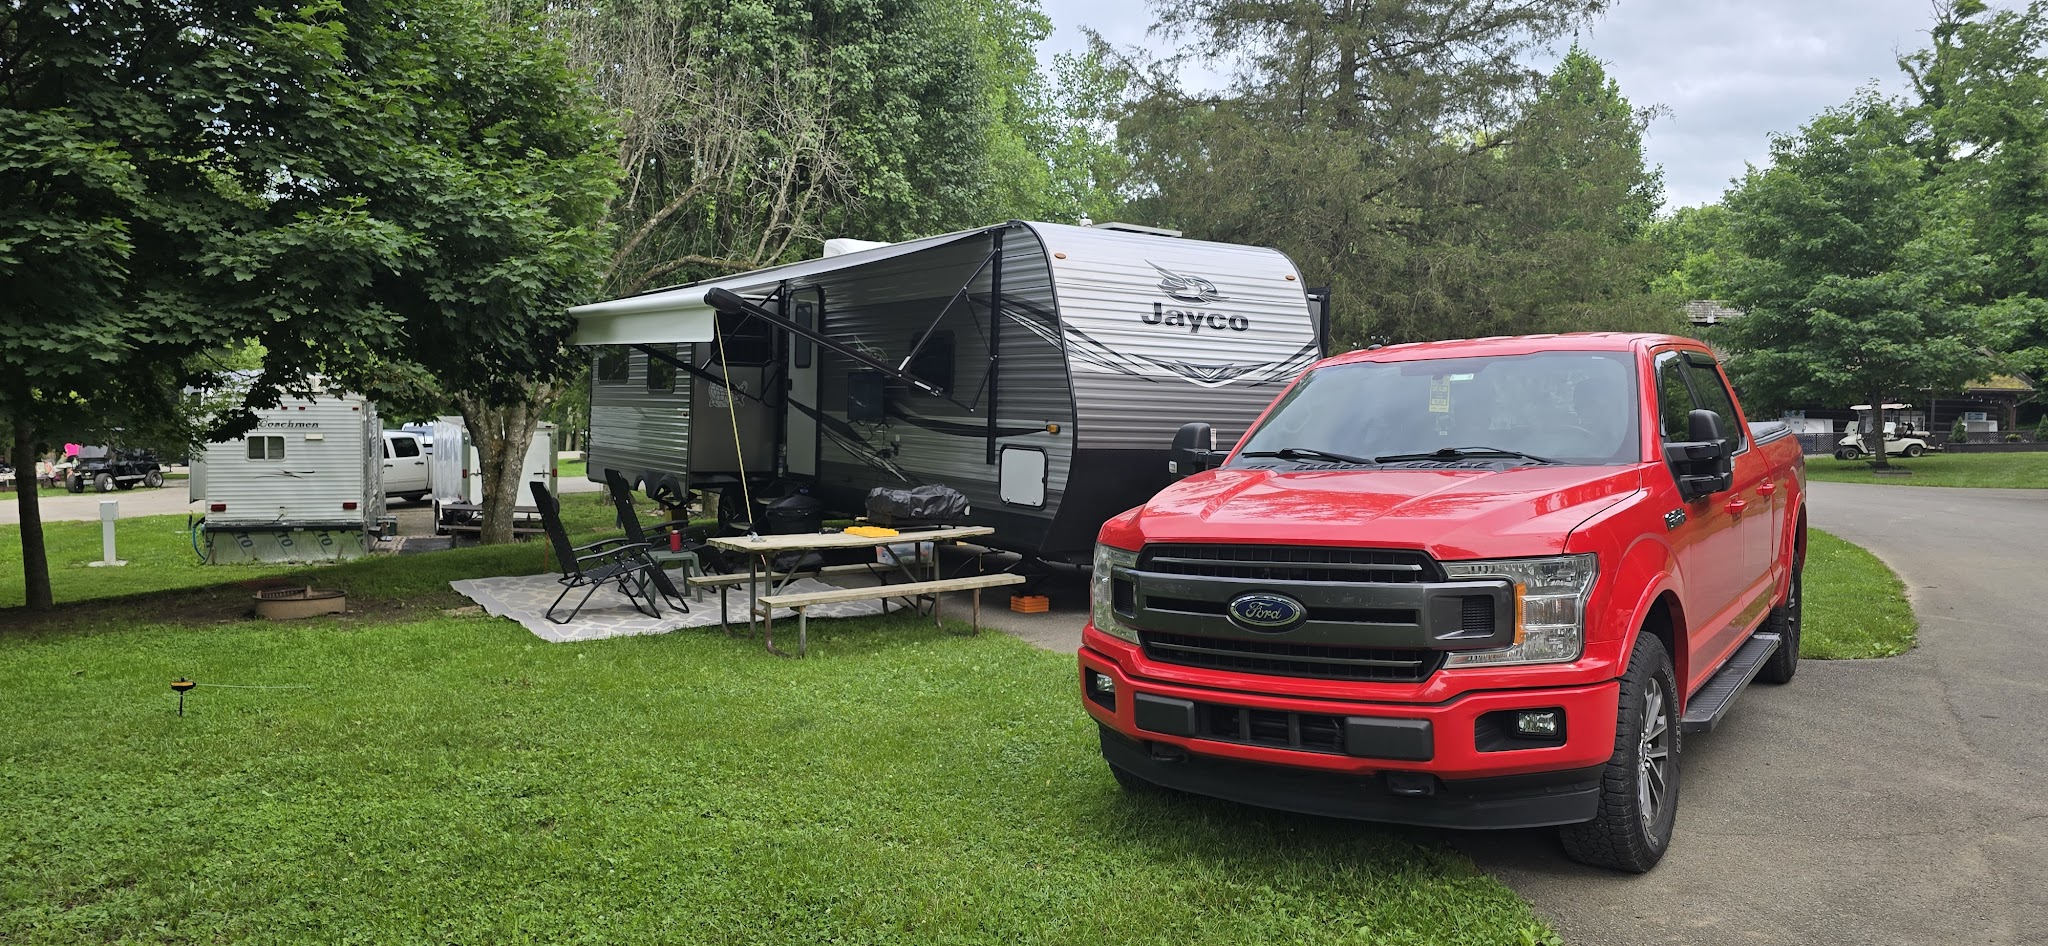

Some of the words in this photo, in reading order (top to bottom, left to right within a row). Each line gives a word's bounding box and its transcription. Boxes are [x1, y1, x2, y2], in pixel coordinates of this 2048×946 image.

[1140, 302, 1249, 333] Jayco
[258, 418, 319, 429] Coachmen
[1245, 601, 1281, 619] Ford
